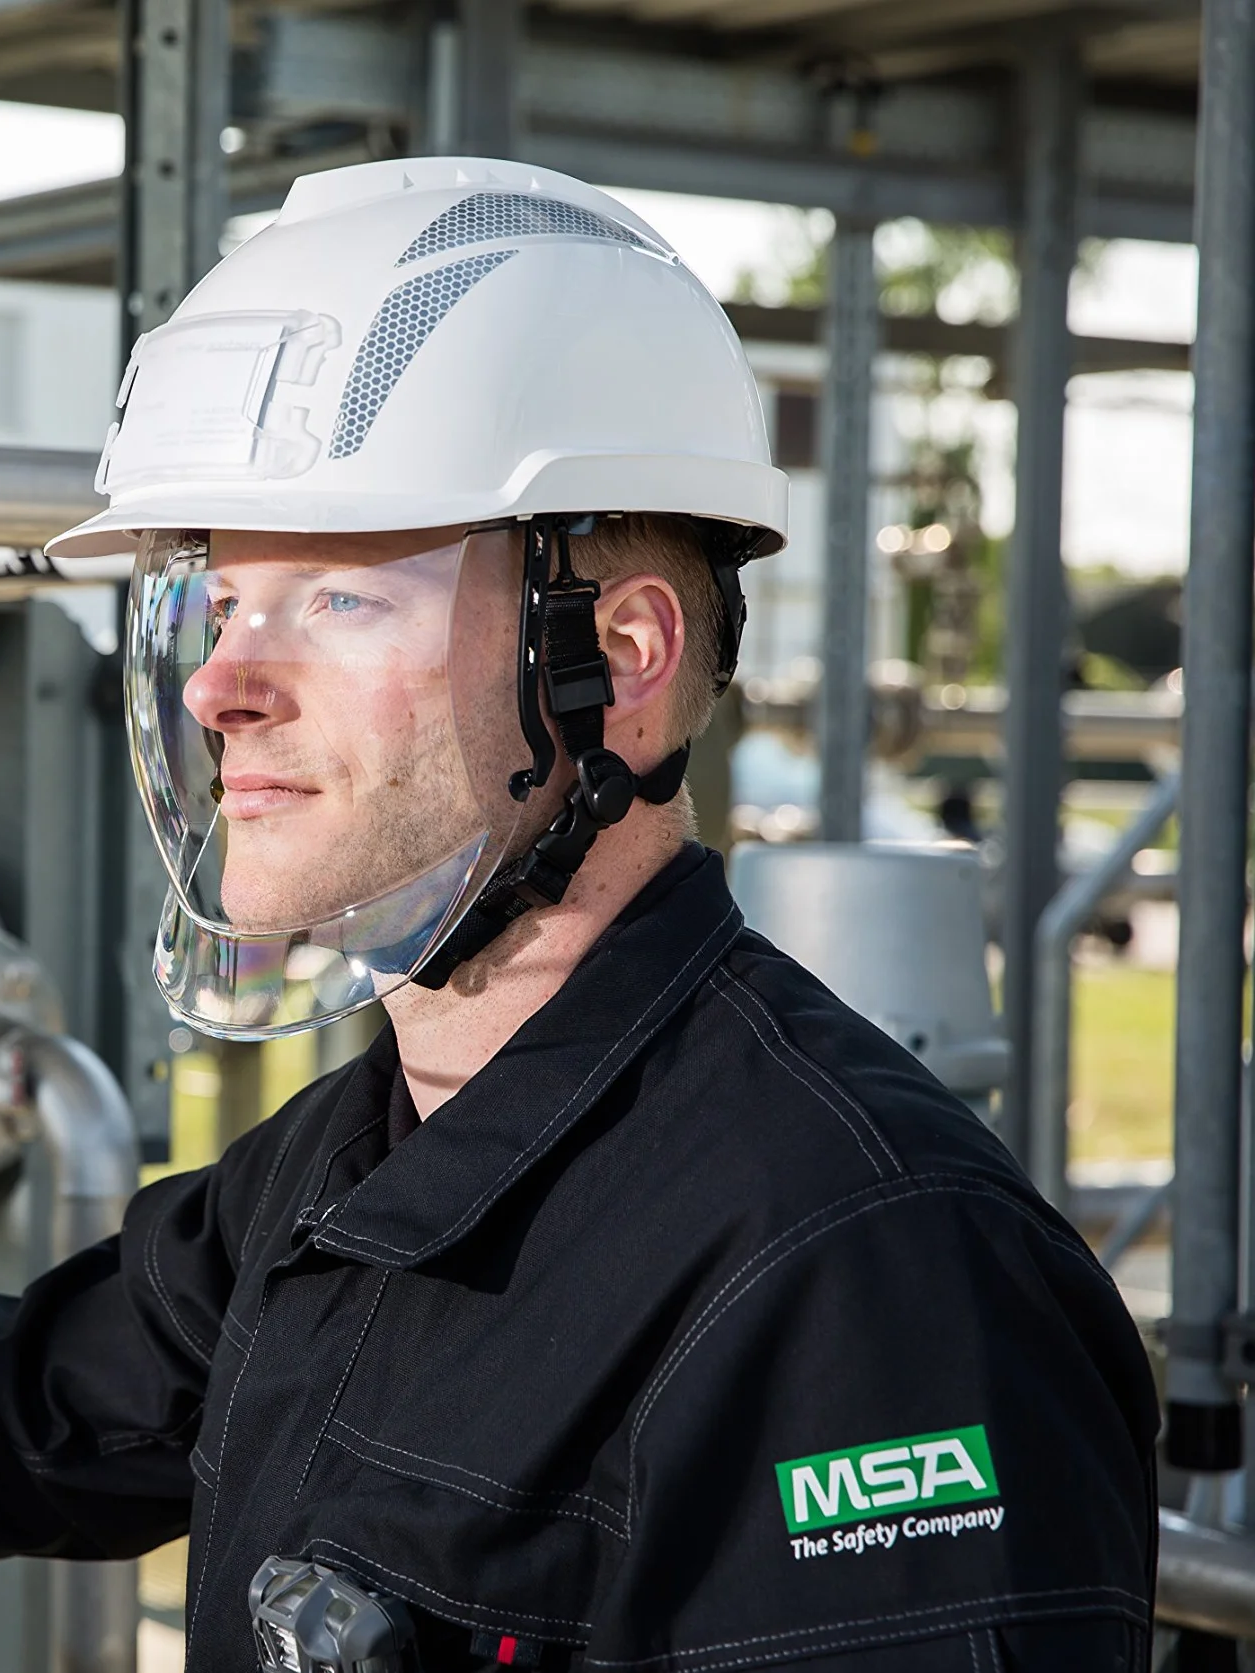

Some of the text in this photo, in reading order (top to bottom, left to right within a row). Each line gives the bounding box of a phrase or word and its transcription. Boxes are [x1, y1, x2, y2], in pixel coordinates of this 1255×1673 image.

[791, 1437, 988, 1524] MSA
[790, 1506, 1005, 1560] The Safety Company
